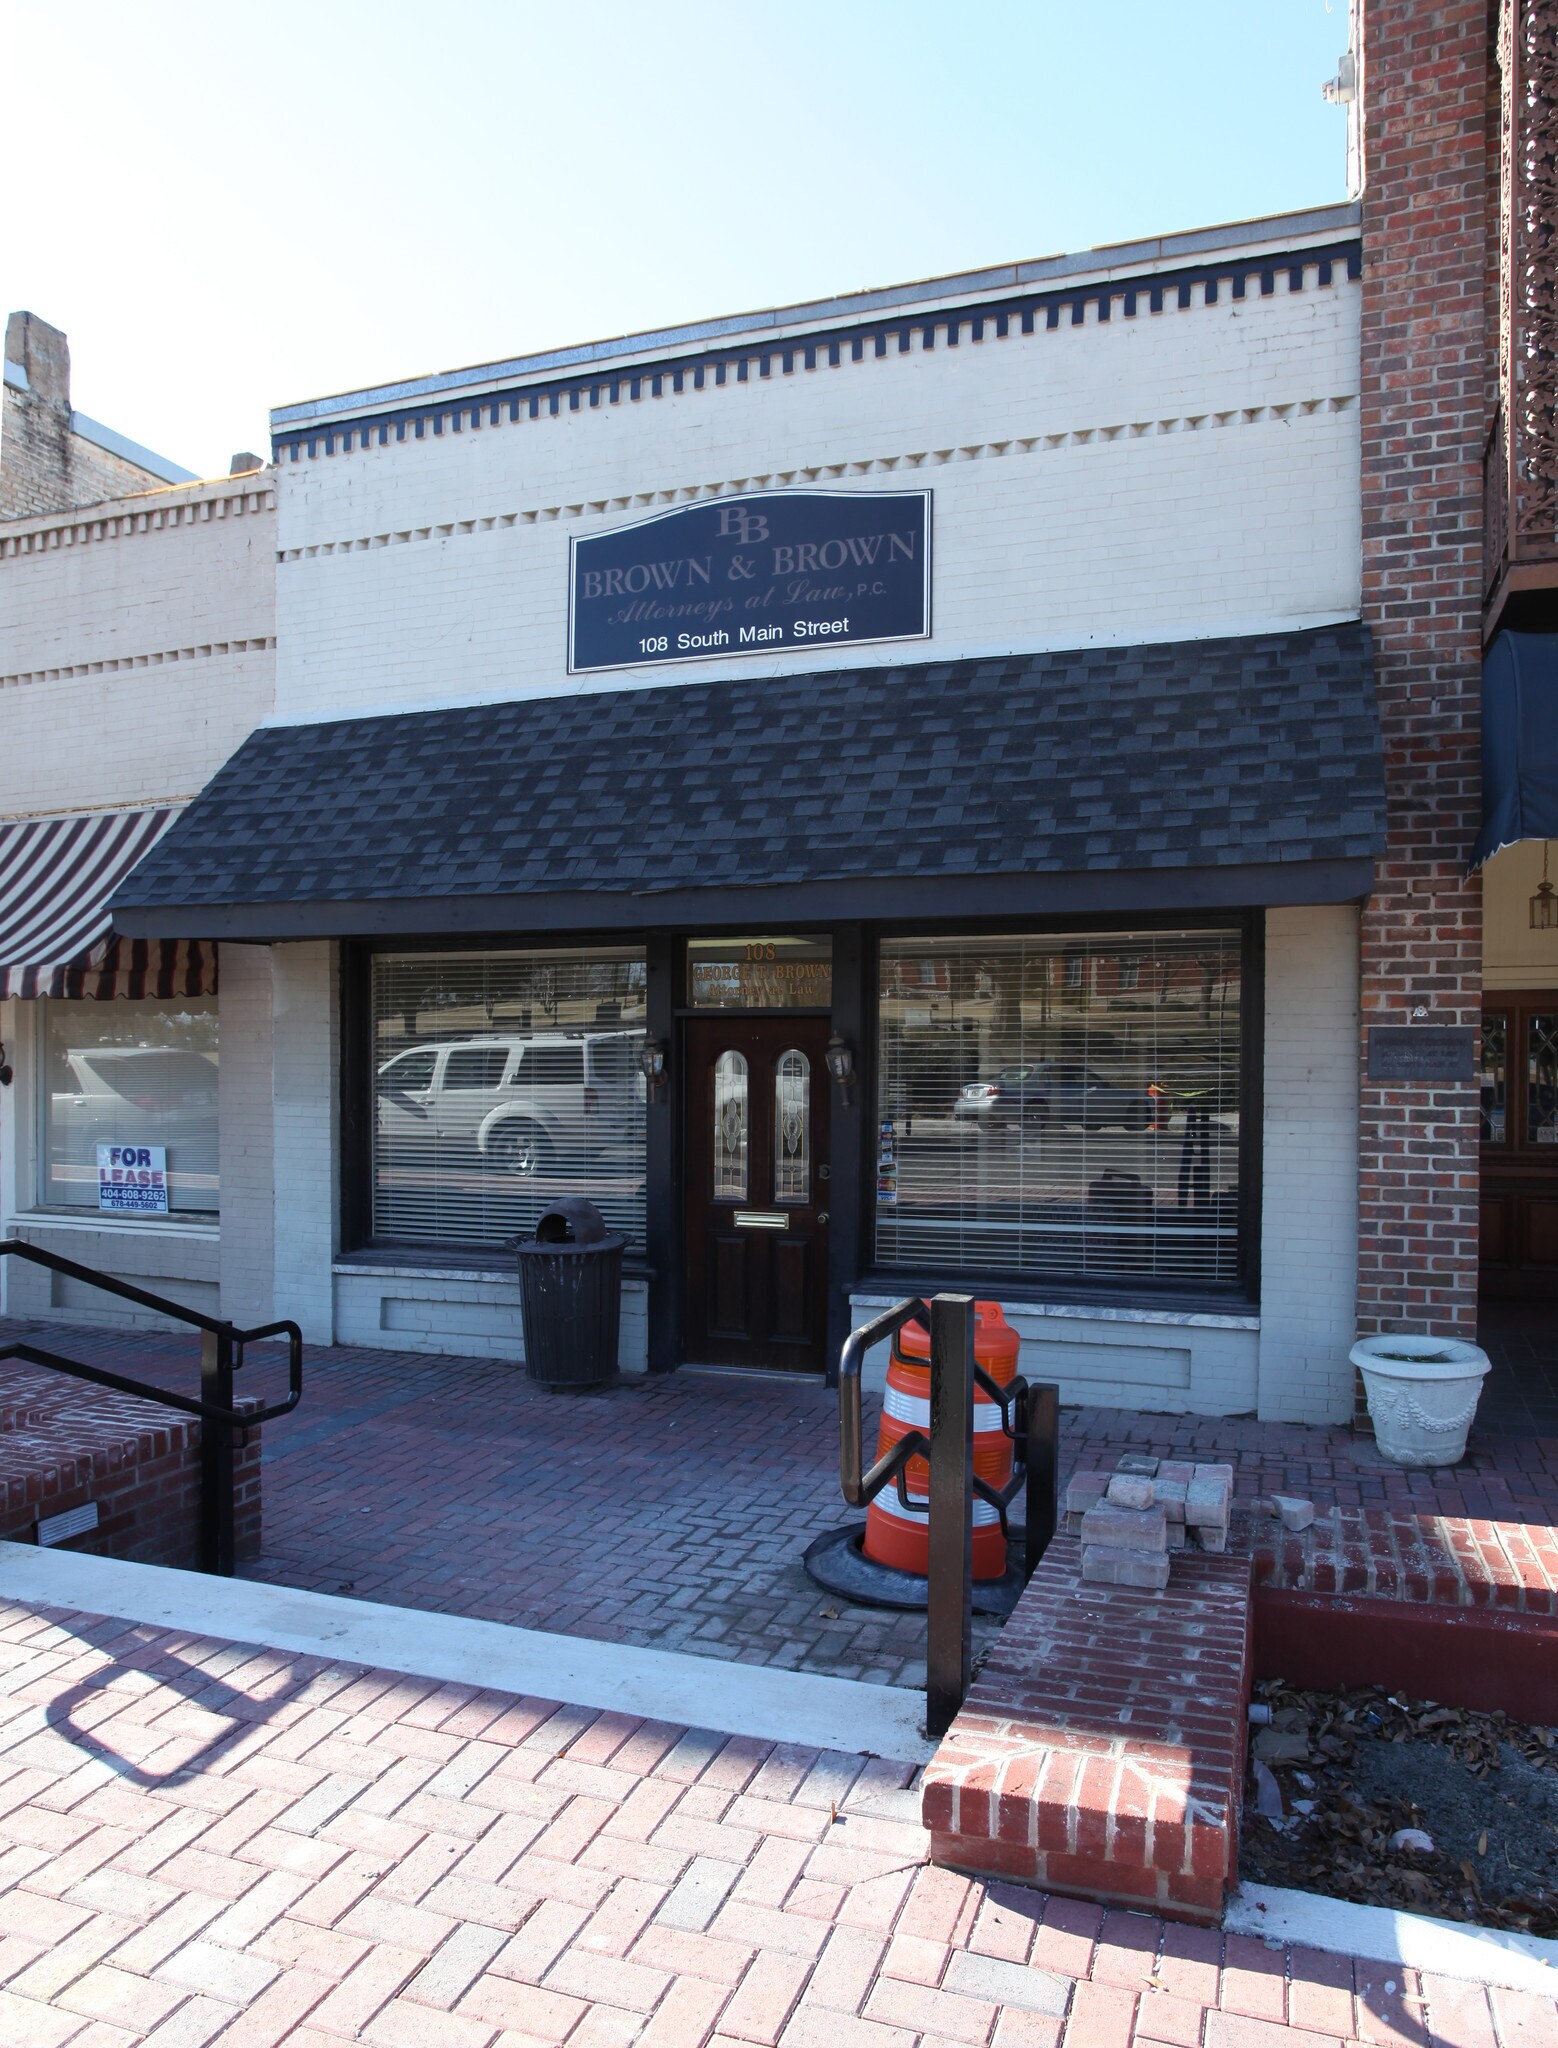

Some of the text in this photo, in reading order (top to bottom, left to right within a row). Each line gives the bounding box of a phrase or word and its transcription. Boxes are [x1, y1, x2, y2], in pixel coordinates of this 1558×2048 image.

[581, 530, 917, 599] BROWN & BROWN
[607, 598, 734, 624] Attorneys
[744, 585, 776, 609] at
[857, 581, 887, 597] P.C.
[638, 617, 849, 653] 108 South Main Street
[745, 943, 776, 961] 108
[694, 965, 752, 981] GEORGE
[775, 963, 830, 979] BROWN
[708, 983, 815, 997] Attorney at Law
[110, 1147, 151, 1167] FOR
[100, 1168, 164, 1189] LEASE
[102, 1189, 164, 1200] 404-608-9262
